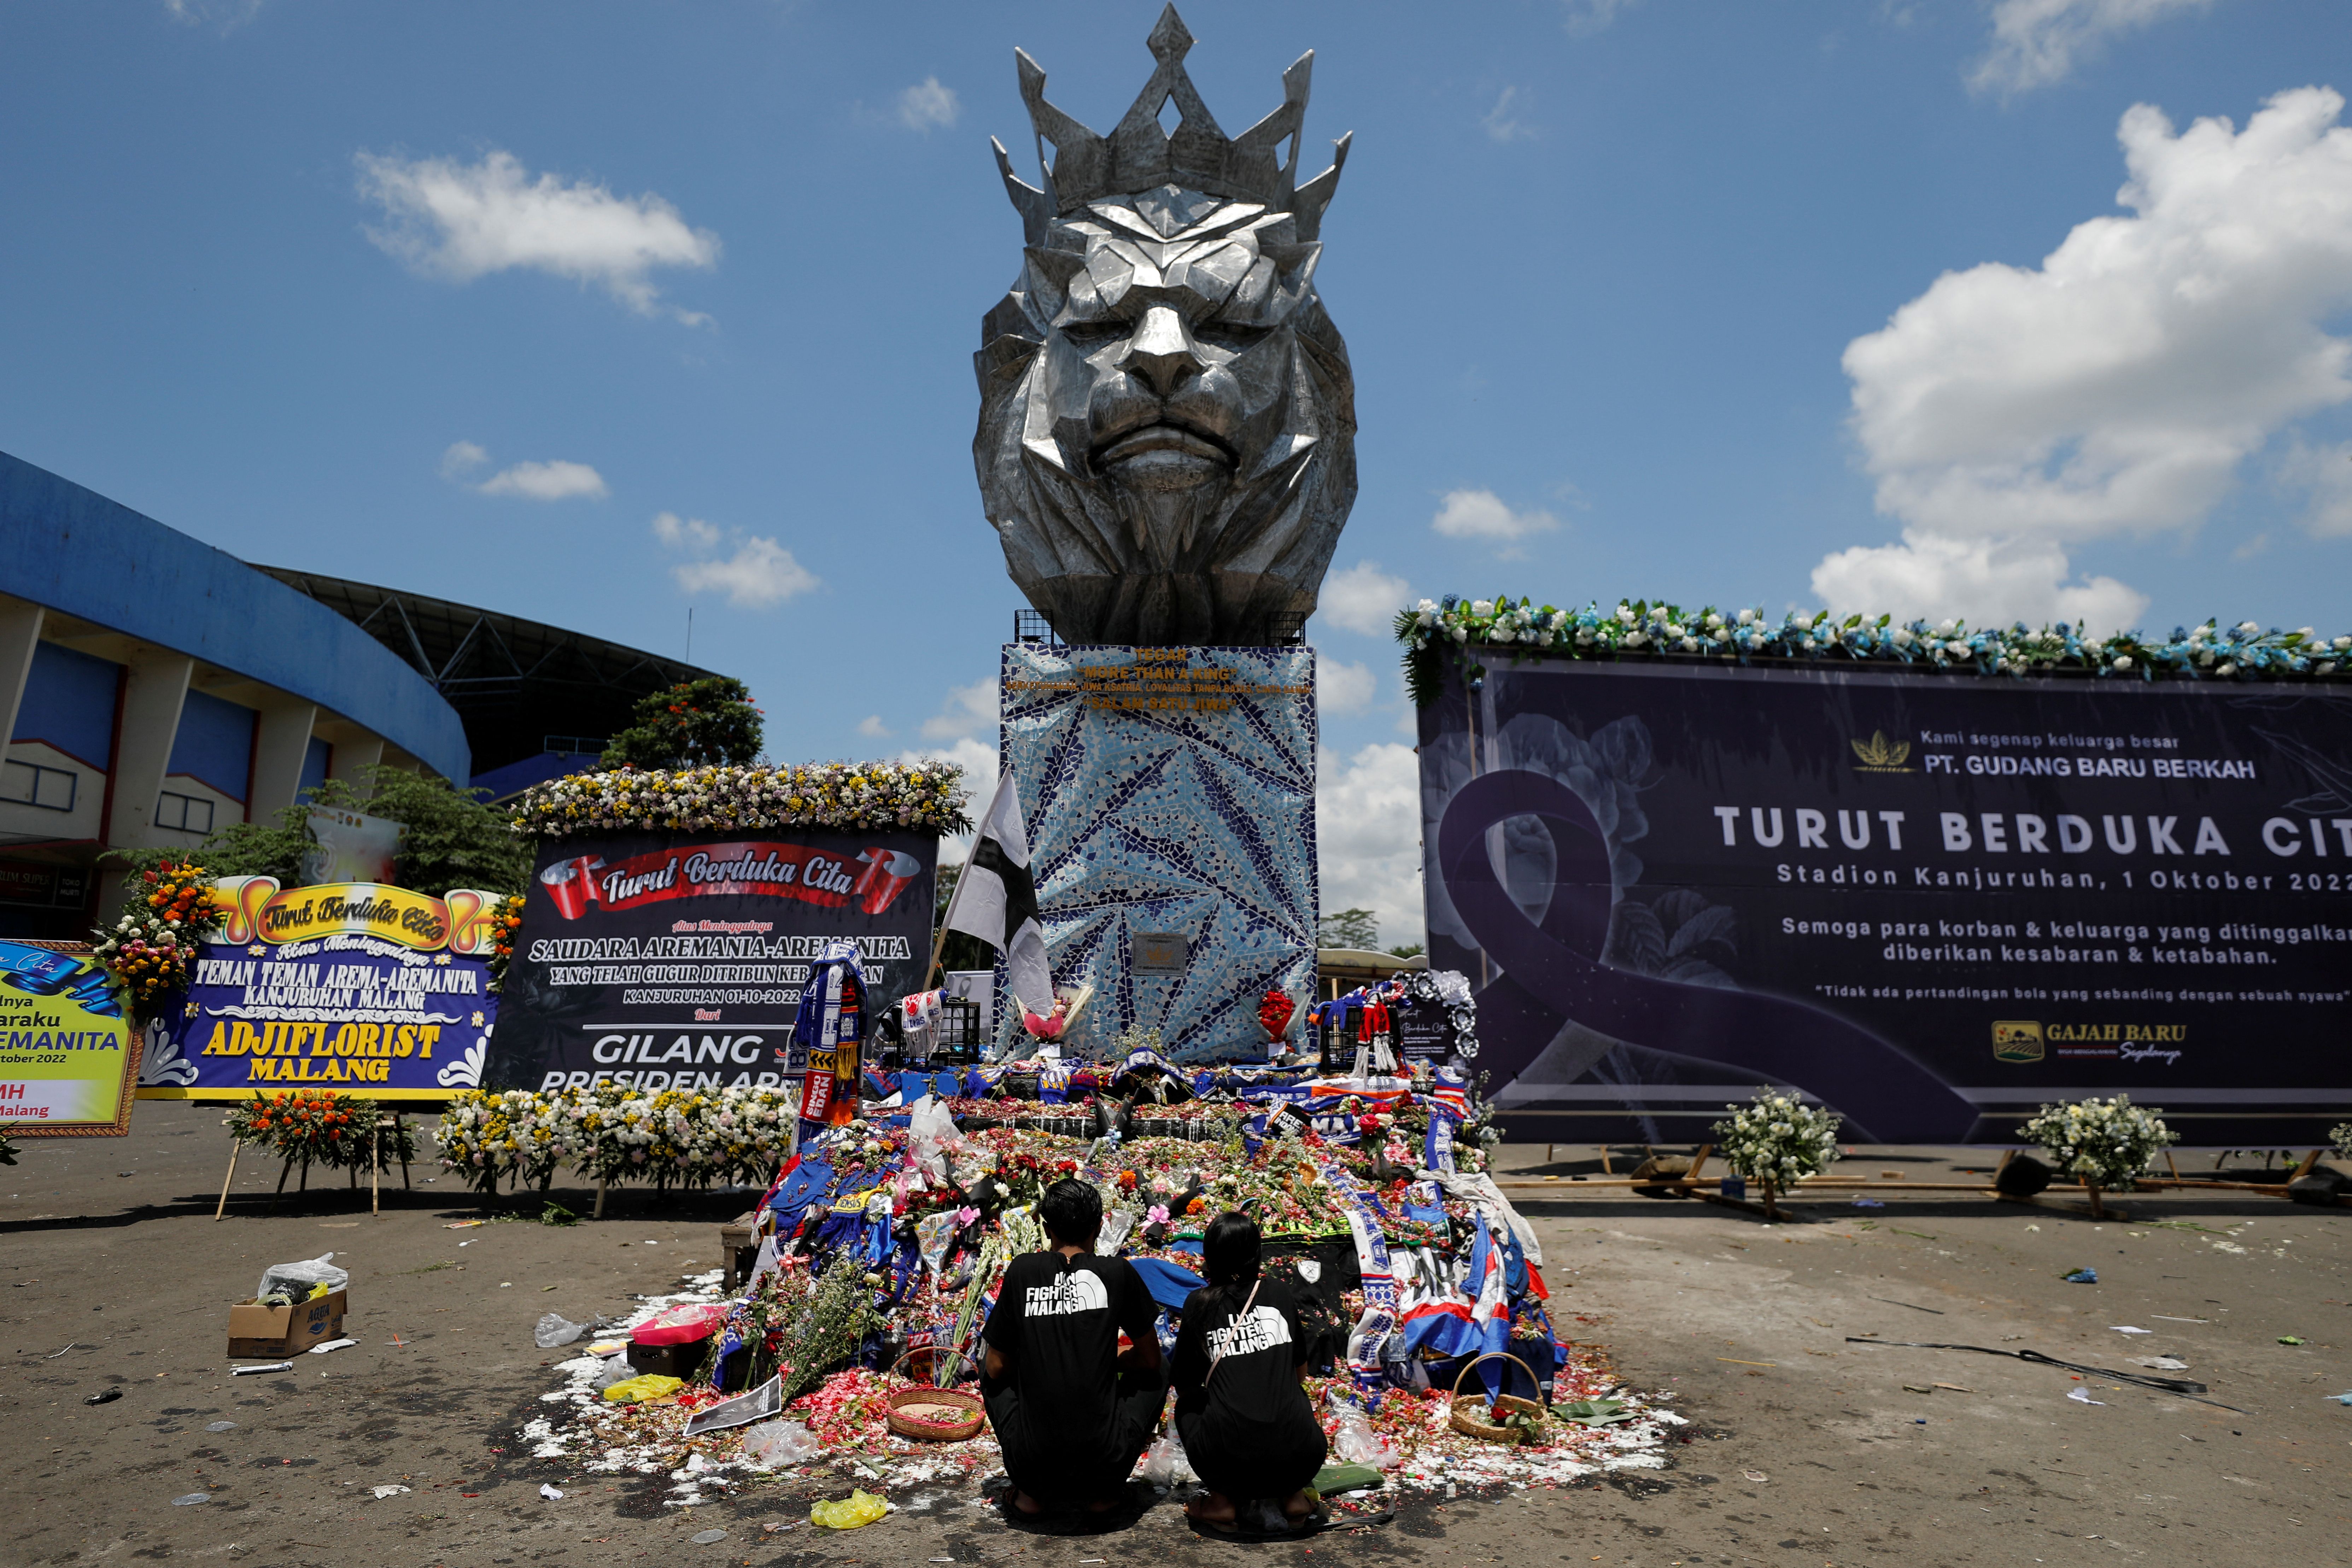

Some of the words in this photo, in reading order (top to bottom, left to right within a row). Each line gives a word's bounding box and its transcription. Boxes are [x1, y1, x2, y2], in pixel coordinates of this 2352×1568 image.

[1135, 648, 1187, 661] TEGAR
[1134, 667, 1175, 679] THAN
[1178, 668, 1188, 679] A
[1081, 683, 1102, 691] JIWA
[1104, 683, 1144, 694] KSATRIA,
[1146, 684, 1191, 692] LOYALITAS
[1195, 684, 1221, 692] TANPA
[1148, 697, 1188, 710] SATU
[1920, 730, 1964, 744] Kami
[1969, 732, 2042, 749] segenap
[2049, 733, 2124, 750] keluarga
[2130, 734, 2179, 749] besar
[1924, 754, 1960, 774] PT.
[1965, 755, 2072, 776] GUDANG
[2077, 757, 2146, 777] BARU
[2152, 759, 2256, 779] BERKAH
[1714, 806, 1905, 850] TURUT
[1939, 812, 2231, 856] BERDUKA
[22, 873, 50, 885] SUPER
[602, 856, 677, 905] Turut
[683, 849, 797, 887] Berduka
[802, 855, 853, 895] Cita
[1777, 864, 1897, 884] Stadion
[1915, 867, 2106, 890] Kanjuruhan,
[2122, 871, 2133, 888] 1
[2150, 870, 2272, 889] Oktober
[265, 899, 314, 931] Turut
[317, 895, 398, 923] Berduka
[402, 906, 447, 940] Cita
[672, 920, 698, 932] Atas
[699, 920, 773, 934] Meninggalnya
[1782, 918, 1871, 938] Semoga
[1880, 921, 1929, 938] para
[1939, 920, 2016, 937] korban
[2026, 922, 2041, 937] &
[2050, 921, 2149, 942] keluarga
[2158, 925, 2211, 943] yang
[275, 941, 320, 961] Atas
[323, 934, 431, 968] Meninggalnya
[529, 937, 640, 962] SAUDARA
[643, 936, 911, 960] AREMANIA-ARENITA
[1883, 944, 1992, 960] diberikan
[2001, 945, 2118, 962] kesabaran
[2128, 947, 2143, 962] &
[2153, 947, 2277, 964] ketabahan.
[16, 952, 59, 973] Cita
[195, 959, 257, 985] TEMAN
[260, 961, 320, 987] TEMAN
[322, 964, 478, 994] AREMA-AREMANITA
[549, 966, 591, 985] YANG
[591, 966, 641, 984] TELAH
[642, 965, 698, 984] GUGUR
[700, 965, 774, 984] DITRIBUN
[242, 985, 352, 1008] KANJURUHAN
[357, 989, 426, 1011] MALANG
[624, 989, 725, 1004] KANJURUHAN
[725, 989, 801, 1004] 01-10-2022
[1873, 987, 1899, 998] ada
[1906, 987, 2008, 1000] pertandingan
[2014, 988, 2047, 999] bola
[2052, 990, 2088, 1002] yang
[2094, 989, 2173, 1002] sebanding
[2179, 989, 2233, 1002] dengan
[2239, 990, 2292, 1001] sebuah
[695, 1008, 721, 1021] Dari
[903, 1016, 925, 1029] ultras
[201, 1021, 441, 1058] ADJIFLORIST
[2046, 1024, 2120, 1041] GAJAH
[2124, 1025, 2187, 1041] BARU
[0, 1054, 35, 1063] tober
[36, 1054, 67, 1063] 2022
[593, 1034, 764, 1063] GILANG
[247, 1059, 390, 1082] MALANG
[806, 1075, 821, 1115] SINGO
[813, 1077, 831, 1117] EDAN
[1279, 1111, 1304, 1130] ARE
[1026, 1285, 1078, 1301] FIGHTER
[307, 1304, 330, 1323] AQUA
[1025, 1298, 1078, 1317] MALANG
[1208, 1335, 1270, 1362] MALANG
